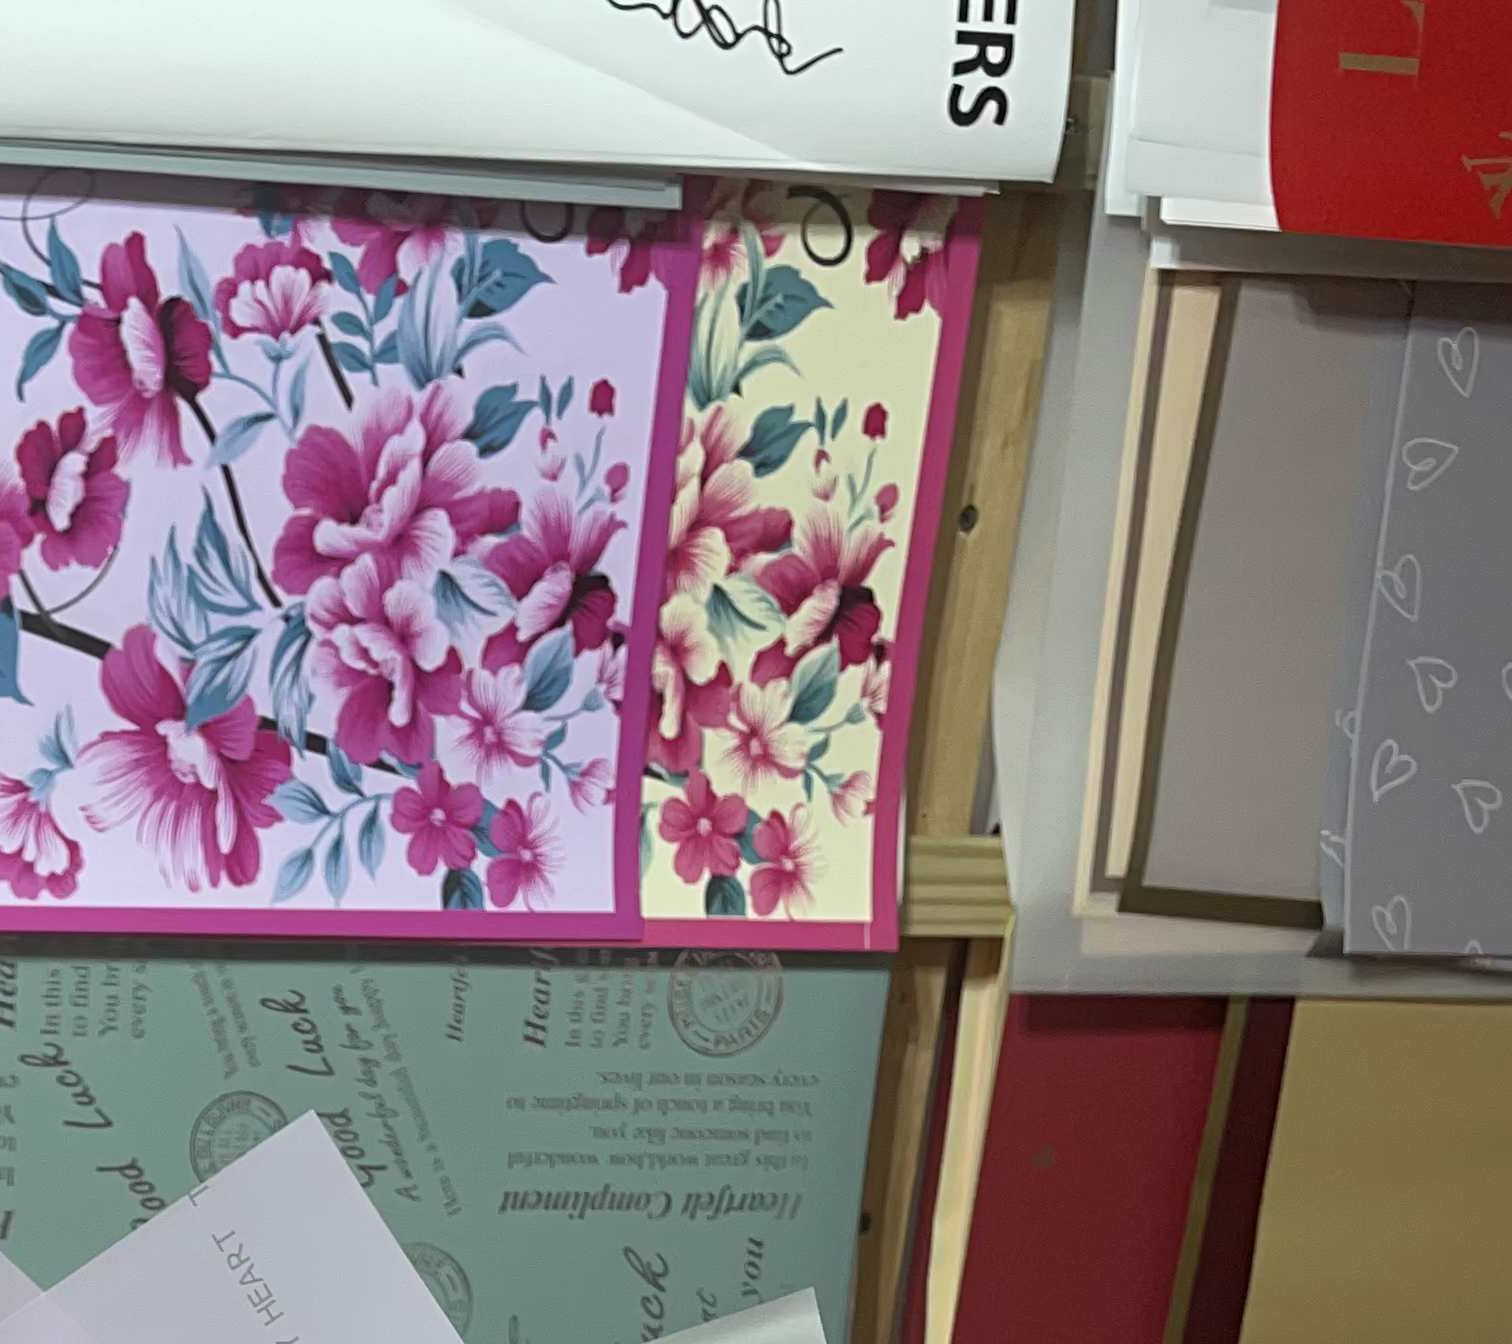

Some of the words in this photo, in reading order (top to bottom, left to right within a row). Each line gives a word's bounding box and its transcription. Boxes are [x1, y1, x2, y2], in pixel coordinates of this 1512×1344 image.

[497, 1183, 673, 1221] Compliment
[679, 1183, 804, 1221] Heartfelt
[210, 1229, 285, 1327] HEART
